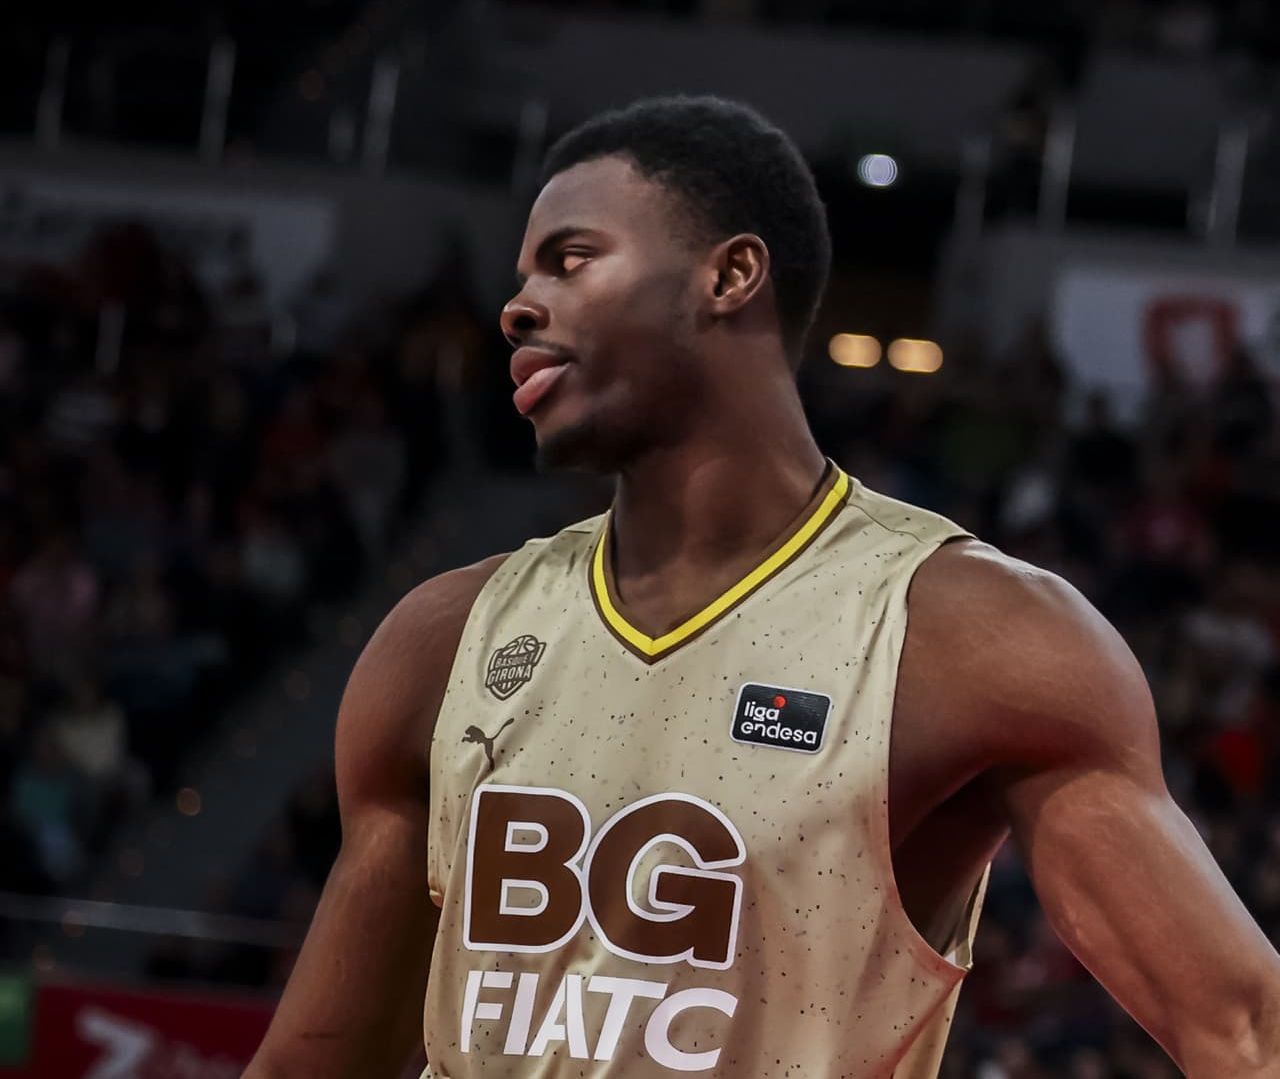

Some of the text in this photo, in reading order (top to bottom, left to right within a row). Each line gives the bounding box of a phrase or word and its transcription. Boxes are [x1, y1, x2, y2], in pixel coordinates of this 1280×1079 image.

[488, 664, 532, 685] GIRONA
[744, 700, 780, 722] liga
[740, 721, 818, 745] endesa
[462, 784, 747, 970] BG
[460, 970, 739, 1072] FIATC
